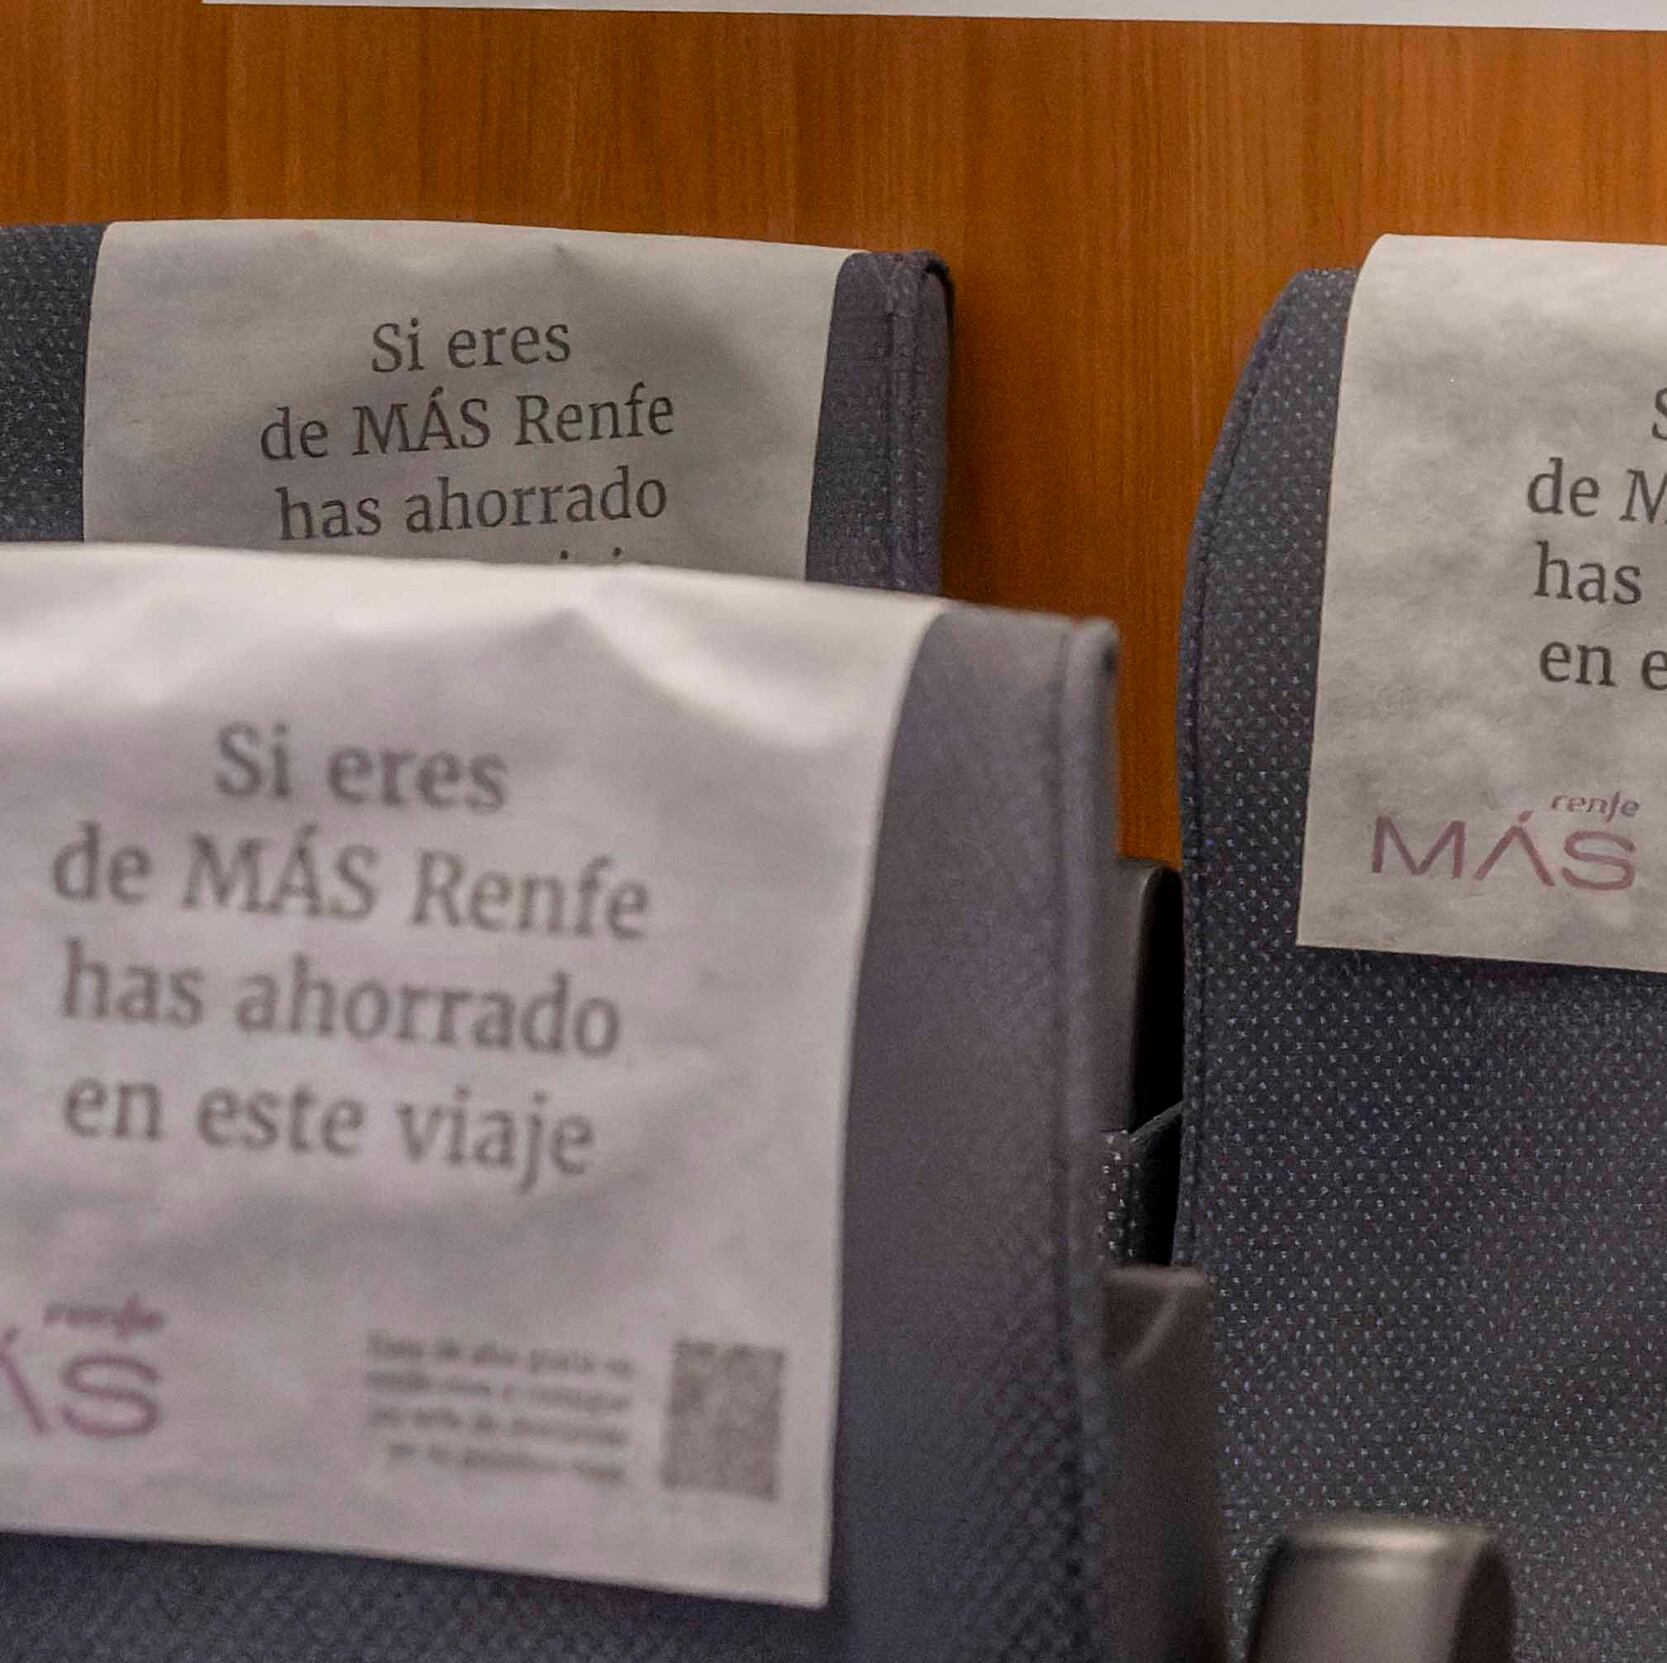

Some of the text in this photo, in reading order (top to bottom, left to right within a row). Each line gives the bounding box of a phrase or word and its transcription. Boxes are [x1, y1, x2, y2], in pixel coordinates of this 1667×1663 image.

[371, 317, 572, 375] Si eres
[259, 379, 674, 463] de MÁS Renfe
[273, 463, 669, 542] has ahorrado
[1526, 455, 1600, 518] de
[1533, 539, 1643, 607] has
[1539, 641, 1616, 688] en
[214, 720, 507, 810] Si eres
[1551, 791, 1641, 823] renfe
[51, 820, 651, 944] de MÁS Renfe
[1371, 810, 1637, 892] MÁS
[60, 936, 623, 1060] has ahorrado
[62, 1077, 598, 1196] en este viaje
